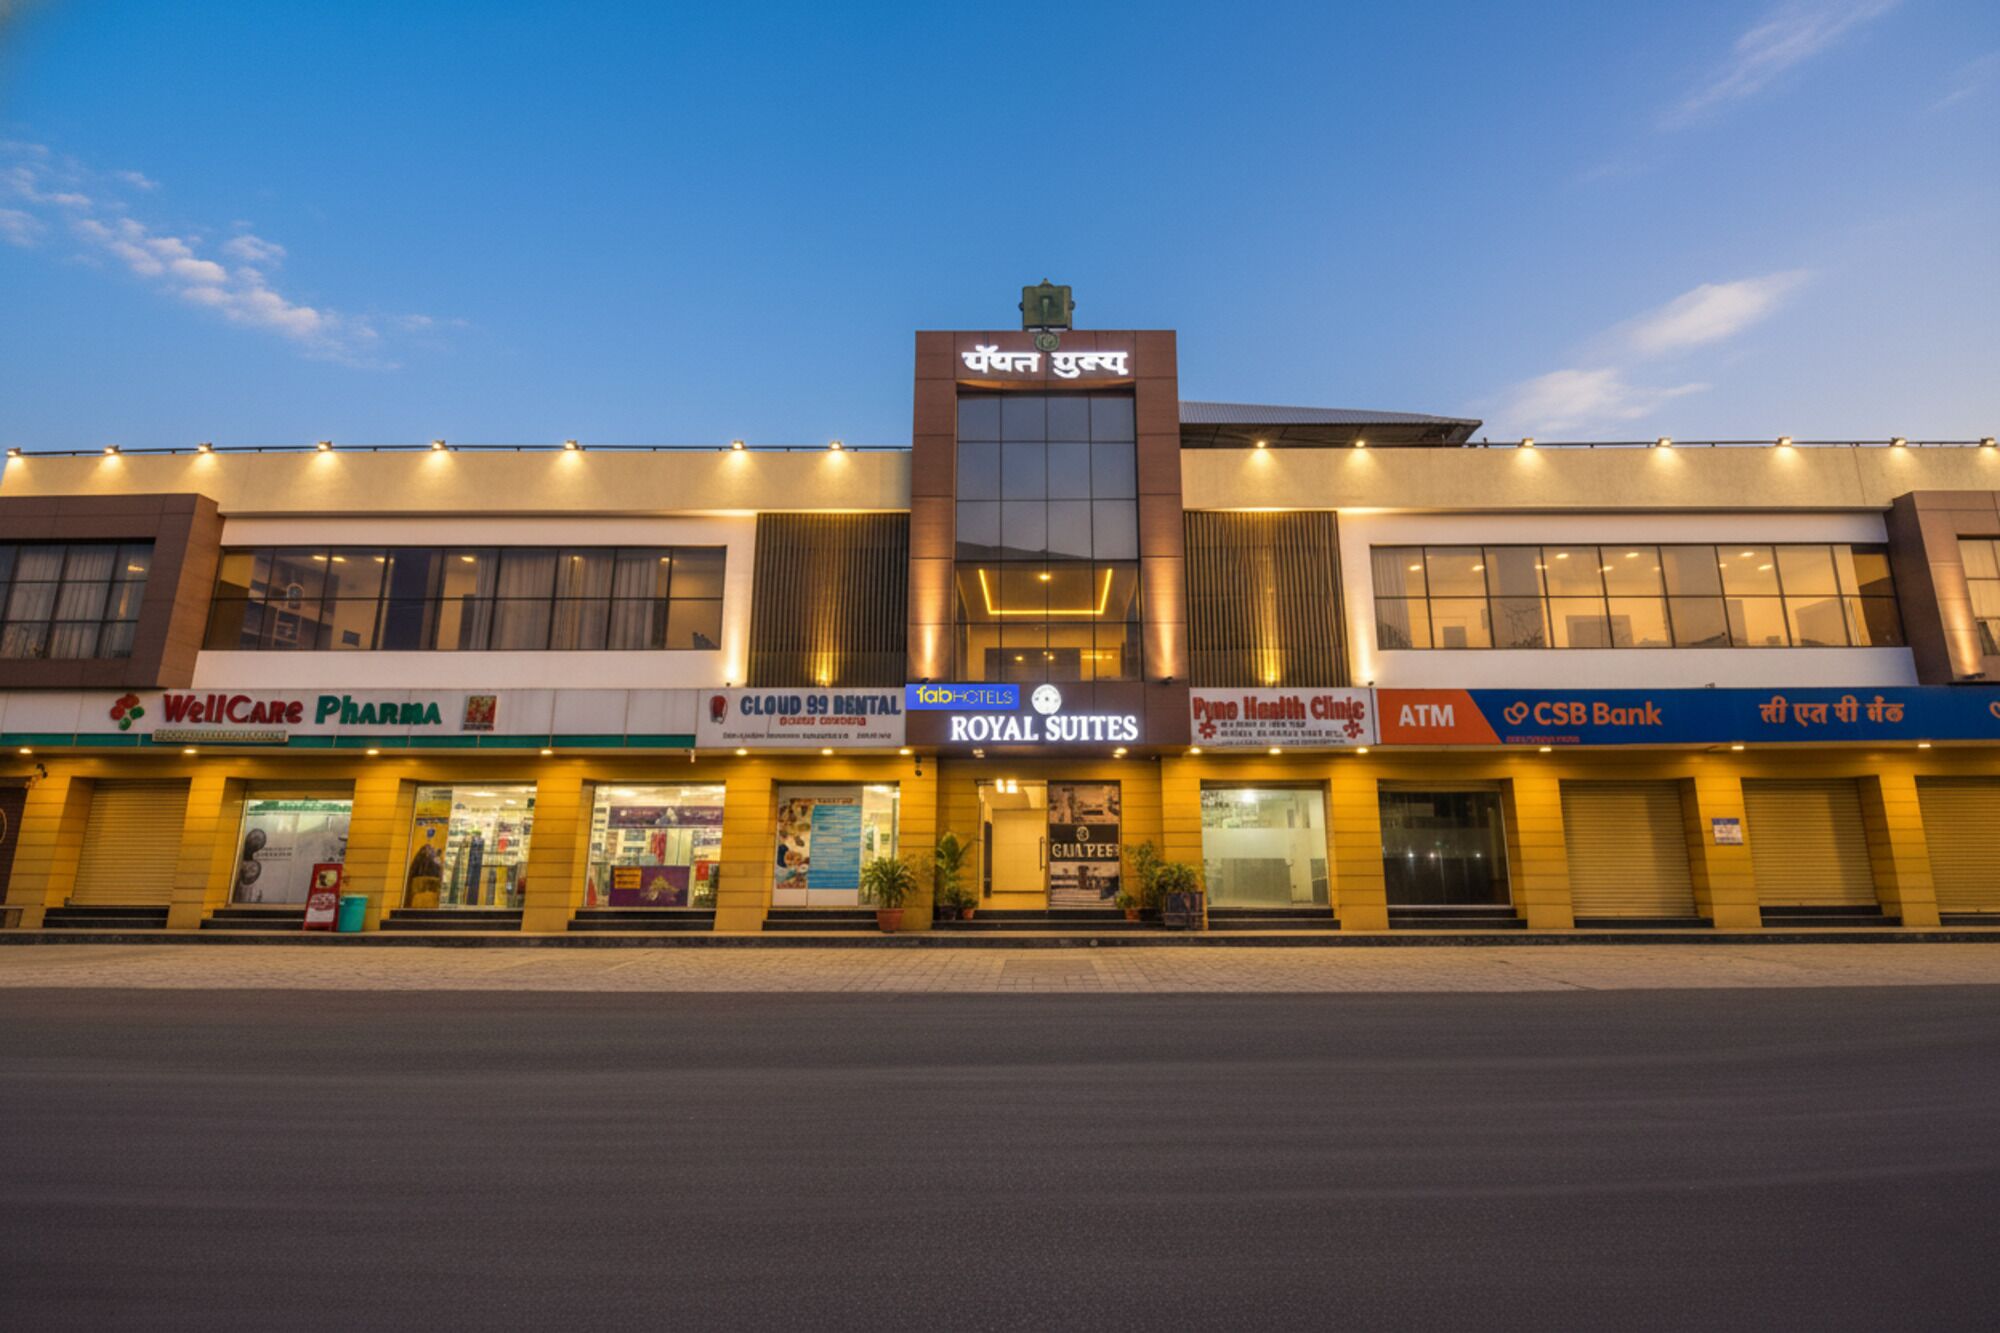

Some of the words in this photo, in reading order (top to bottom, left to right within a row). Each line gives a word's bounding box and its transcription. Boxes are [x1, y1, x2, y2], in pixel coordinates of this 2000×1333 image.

[314, 695, 442, 724] Pharma
[740, 695, 802, 716] CLOUD
[806, 695, 829, 715] 99
[833, 695, 902, 716] DENTAL
[1243, 696, 1307, 721] Health
[1310, 696, 1366, 721] Clinic
[1399, 704, 1456, 727] ATM
[1534, 702, 1588, 726] CSB
[1593, 701, 1663, 725] Bank
[951, 715, 1040, 741] ROYAL
[1045, 715, 1139, 741] SUITES
